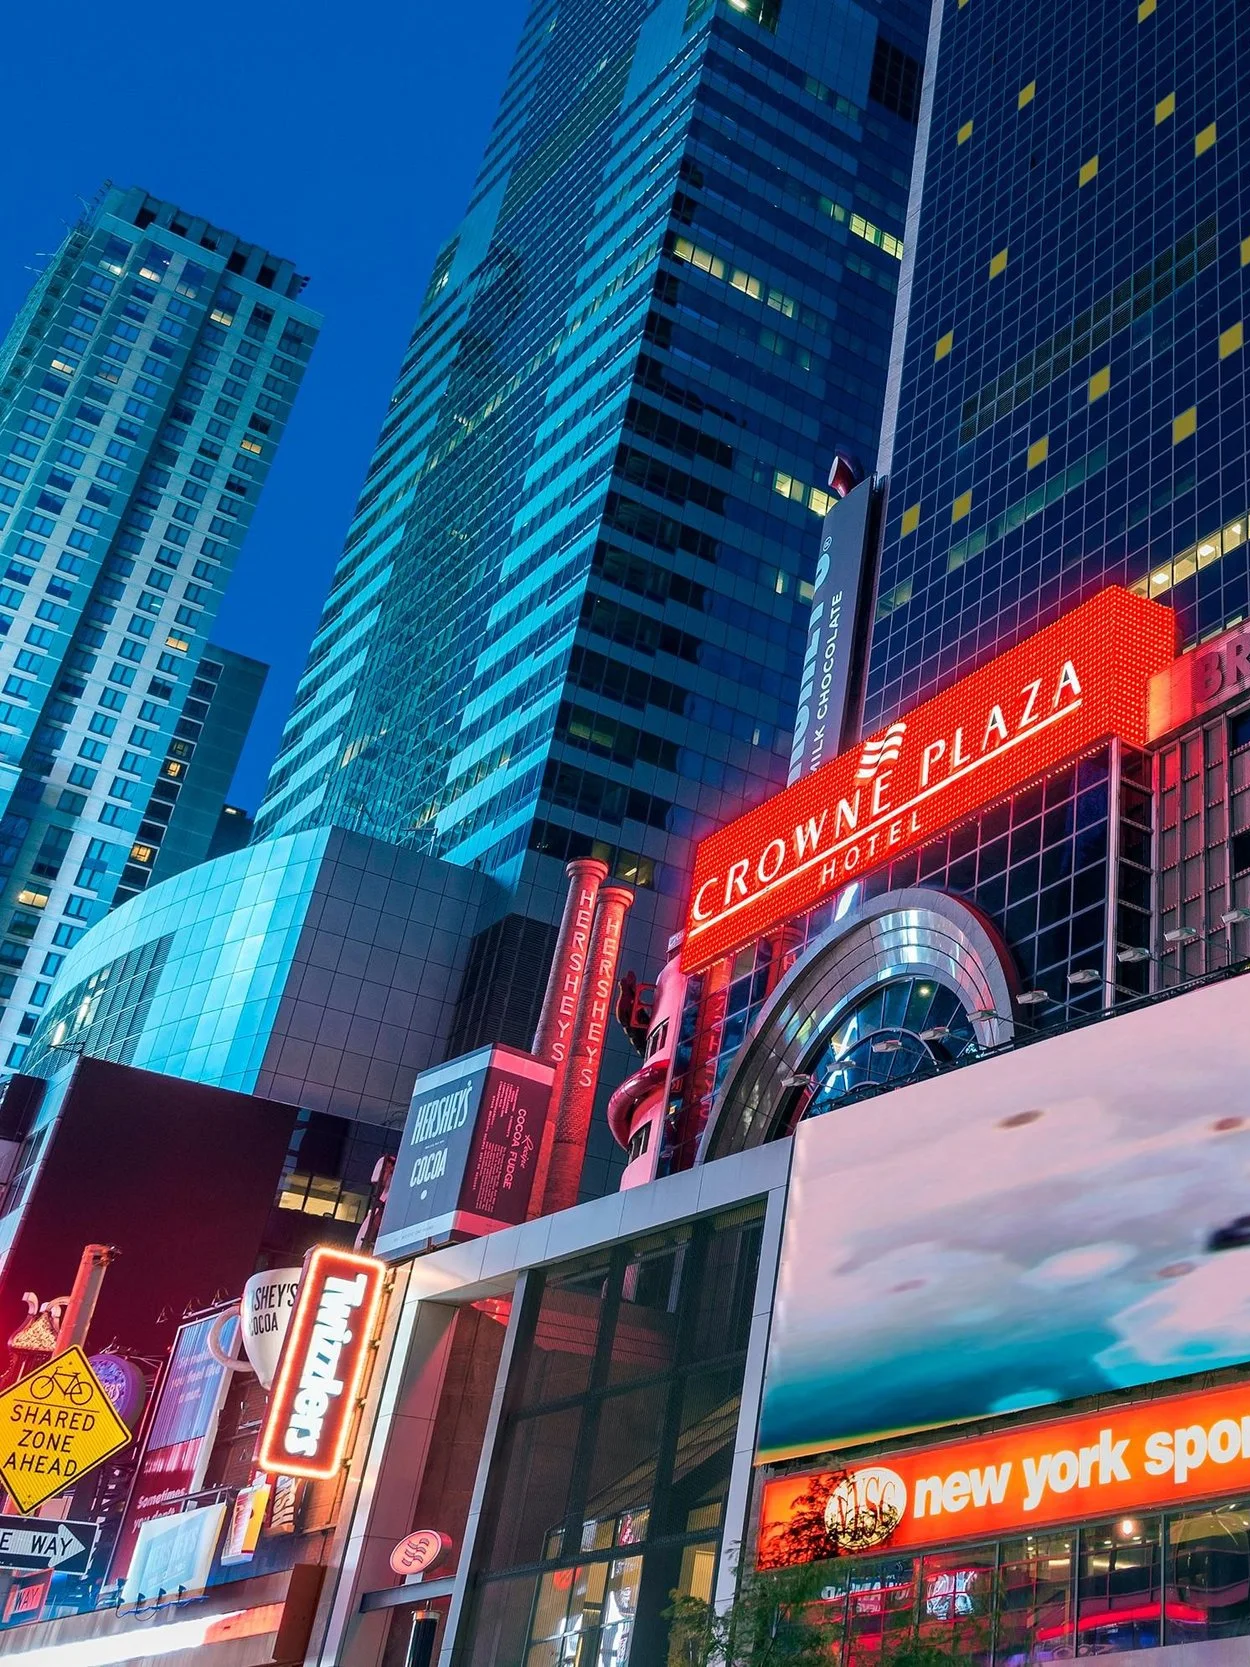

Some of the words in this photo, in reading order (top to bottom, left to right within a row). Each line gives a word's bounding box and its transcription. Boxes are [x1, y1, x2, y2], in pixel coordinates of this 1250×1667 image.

[817, 590, 843, 720] CHOCOLATE
[692, 770, 893, 923] CROWNE
[919, 659, 1082, 787] PLAZA
[820, 810, 922, 886] HOTEL
[410, 1080, 473, 1146] HERSHEY'S
[511, 1108, 527, 1148] COCOA
[410, 1148, 448, 1187] COCOA
[502, 1151, 518, 1190] FUDGE
[519, 1134, 533, 1169] Recipe
[284, 1273, 368, 1457] Twizzlers
[10, 1404, 95, 1432] SHARED
[18, 1429, 75, 1453] ZONE
[3, 1452, 77, 1477] AHEAD
[912, 1461, 1014, 1519] new
[1022, 1430, 1132, 1511] york
[31, 1535, 73, 1556] WAY
